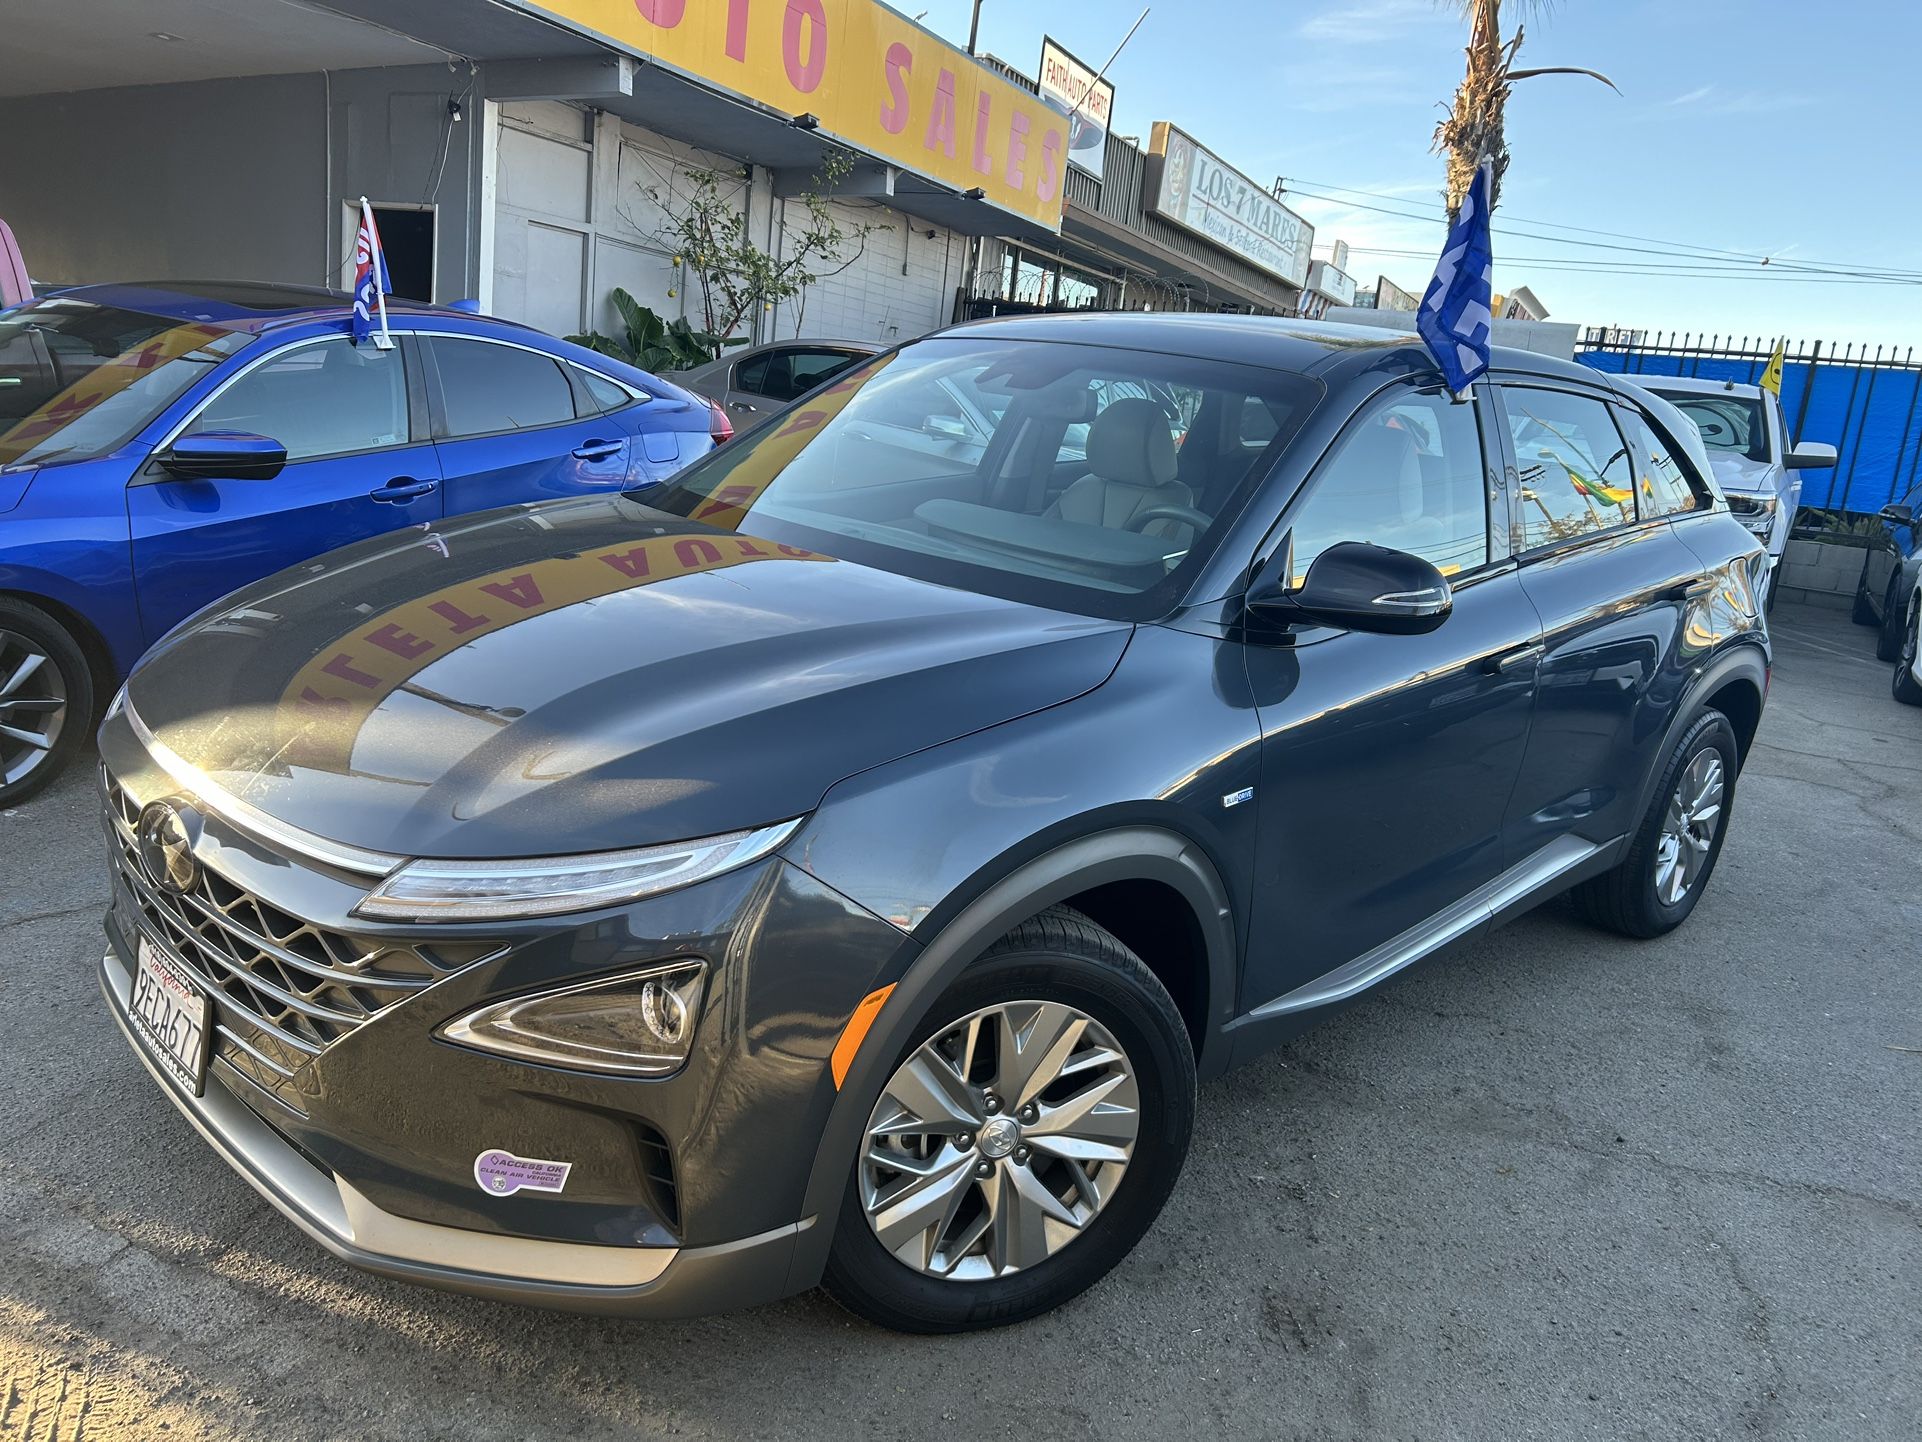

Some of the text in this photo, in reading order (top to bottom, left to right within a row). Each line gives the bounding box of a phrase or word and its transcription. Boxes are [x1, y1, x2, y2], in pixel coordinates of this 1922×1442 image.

[635, 0, 1062, 204] TO SALES
[1045, 58, 1108, 120] FAITH AUTO PARTS
[1196, 159, 1297, 250] LOS 7 MARES
[128, 1010, 197, 1095] arletaautosales.com
[135, 967, 202, 1070] 9ECA677
[480, 1167, 507, 1176] CLEAN
[526, 1174, 560, 1182] VEHICLE
[499, 1160, 563, 1173] ACCESS OK
